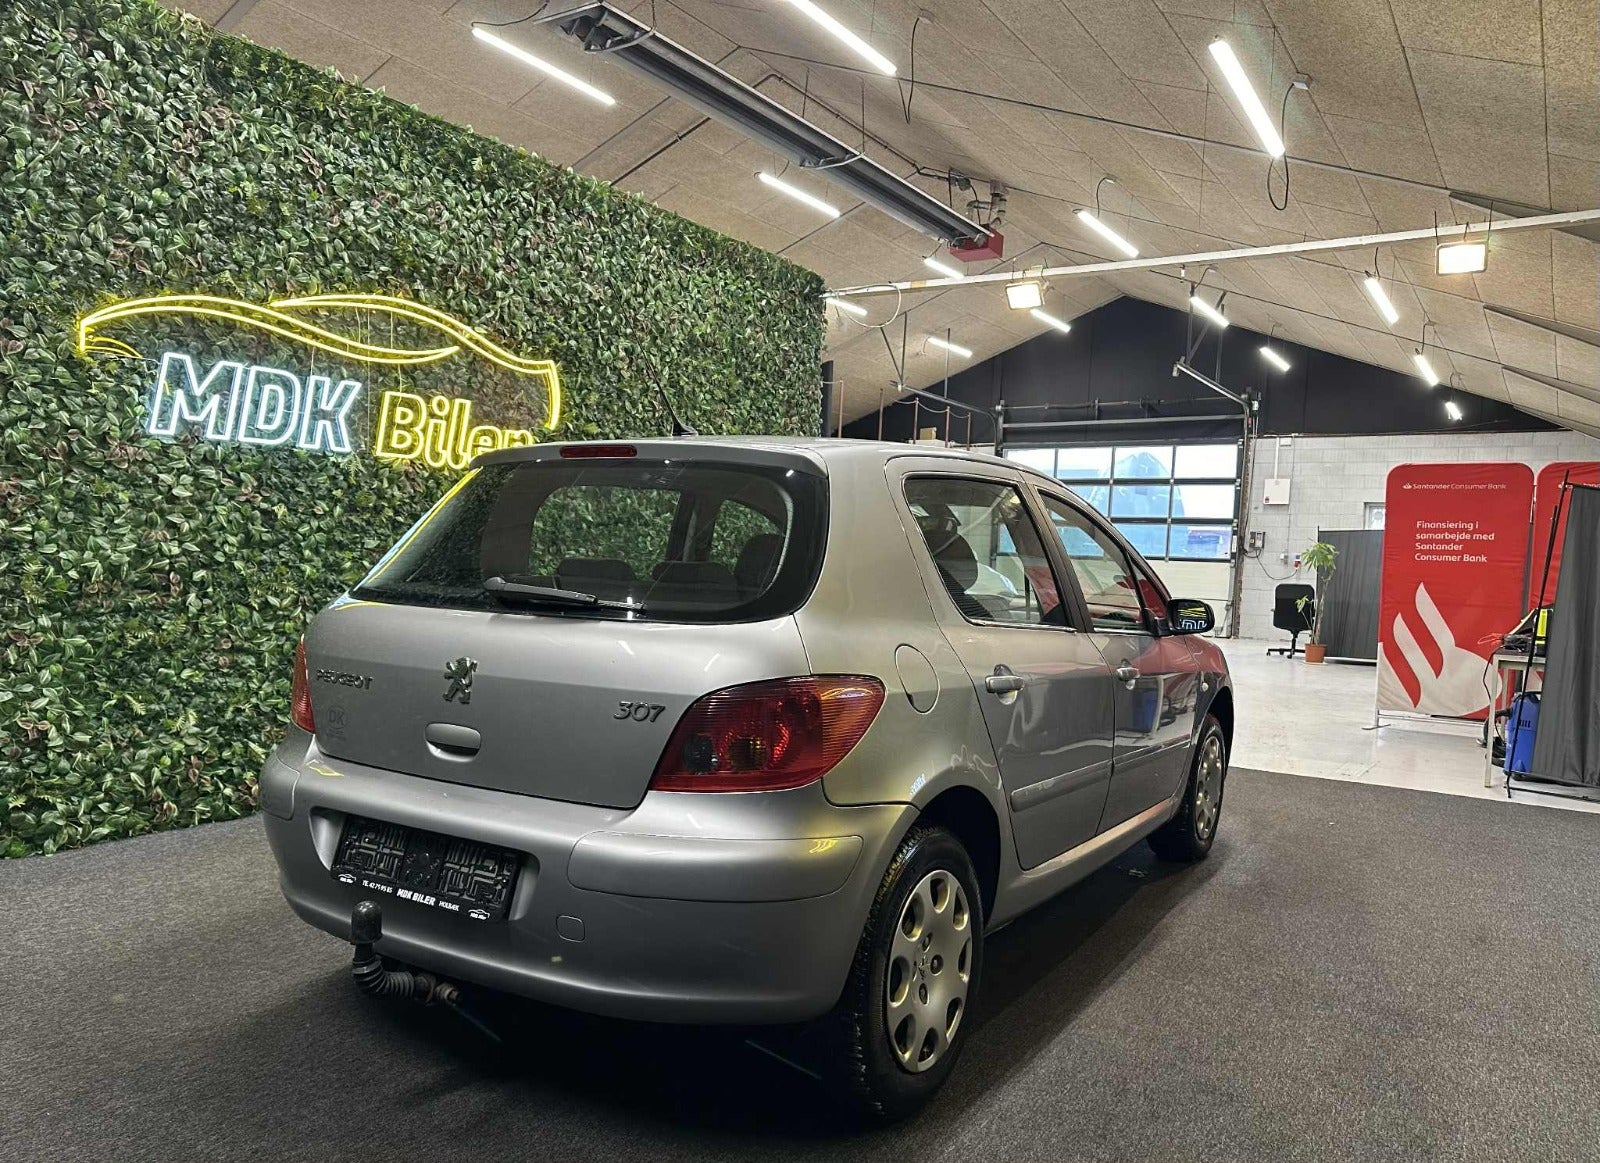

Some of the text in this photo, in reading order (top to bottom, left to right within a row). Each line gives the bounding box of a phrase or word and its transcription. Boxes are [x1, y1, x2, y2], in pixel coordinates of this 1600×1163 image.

[148, 352, 362, 453] MDK
[1416, 520, 1479, 530] Finansiering i
[1415, 531, 1495, 541] samarbejde med
[1415, 542, 1464, 551] Santander
[1414, 553, 1488, 563] Consumer Bank
[316, 668, 375, 690] PEUGEOT
[613, 700, 666, 723] 307
[396, 888, 413, 900] MDK
[412, 892, 436, 906] BILER
